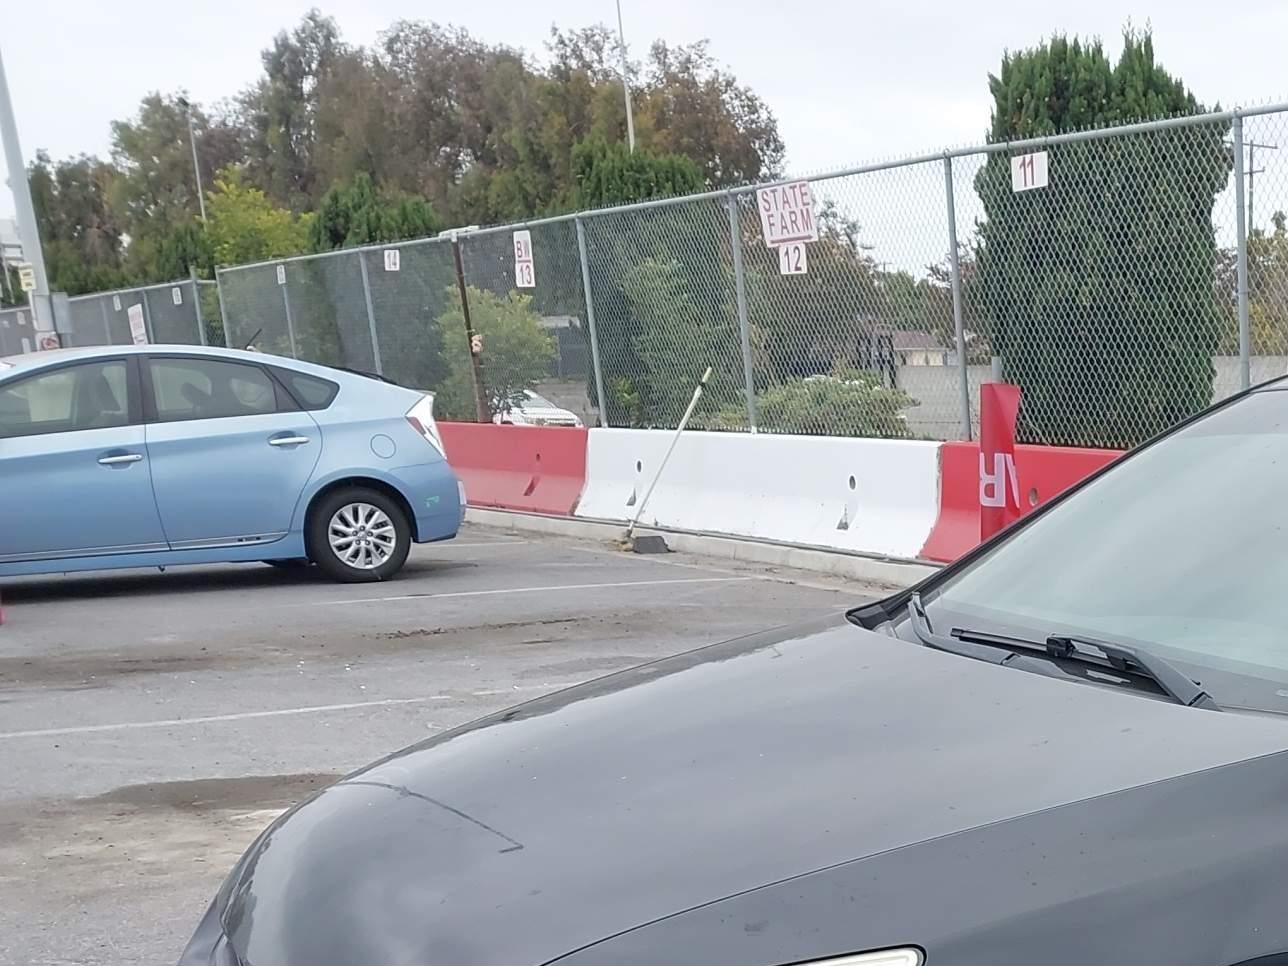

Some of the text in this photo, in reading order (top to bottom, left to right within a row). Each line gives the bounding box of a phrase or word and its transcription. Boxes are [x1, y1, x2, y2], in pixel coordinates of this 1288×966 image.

[1019, 154, 1034, 187] 11
[761, 183, 810, 212] STATE
[767, 207, 813, 237] FARM
[784, 245, 802, 272] 12
[519, 264, 532, 285] 13
